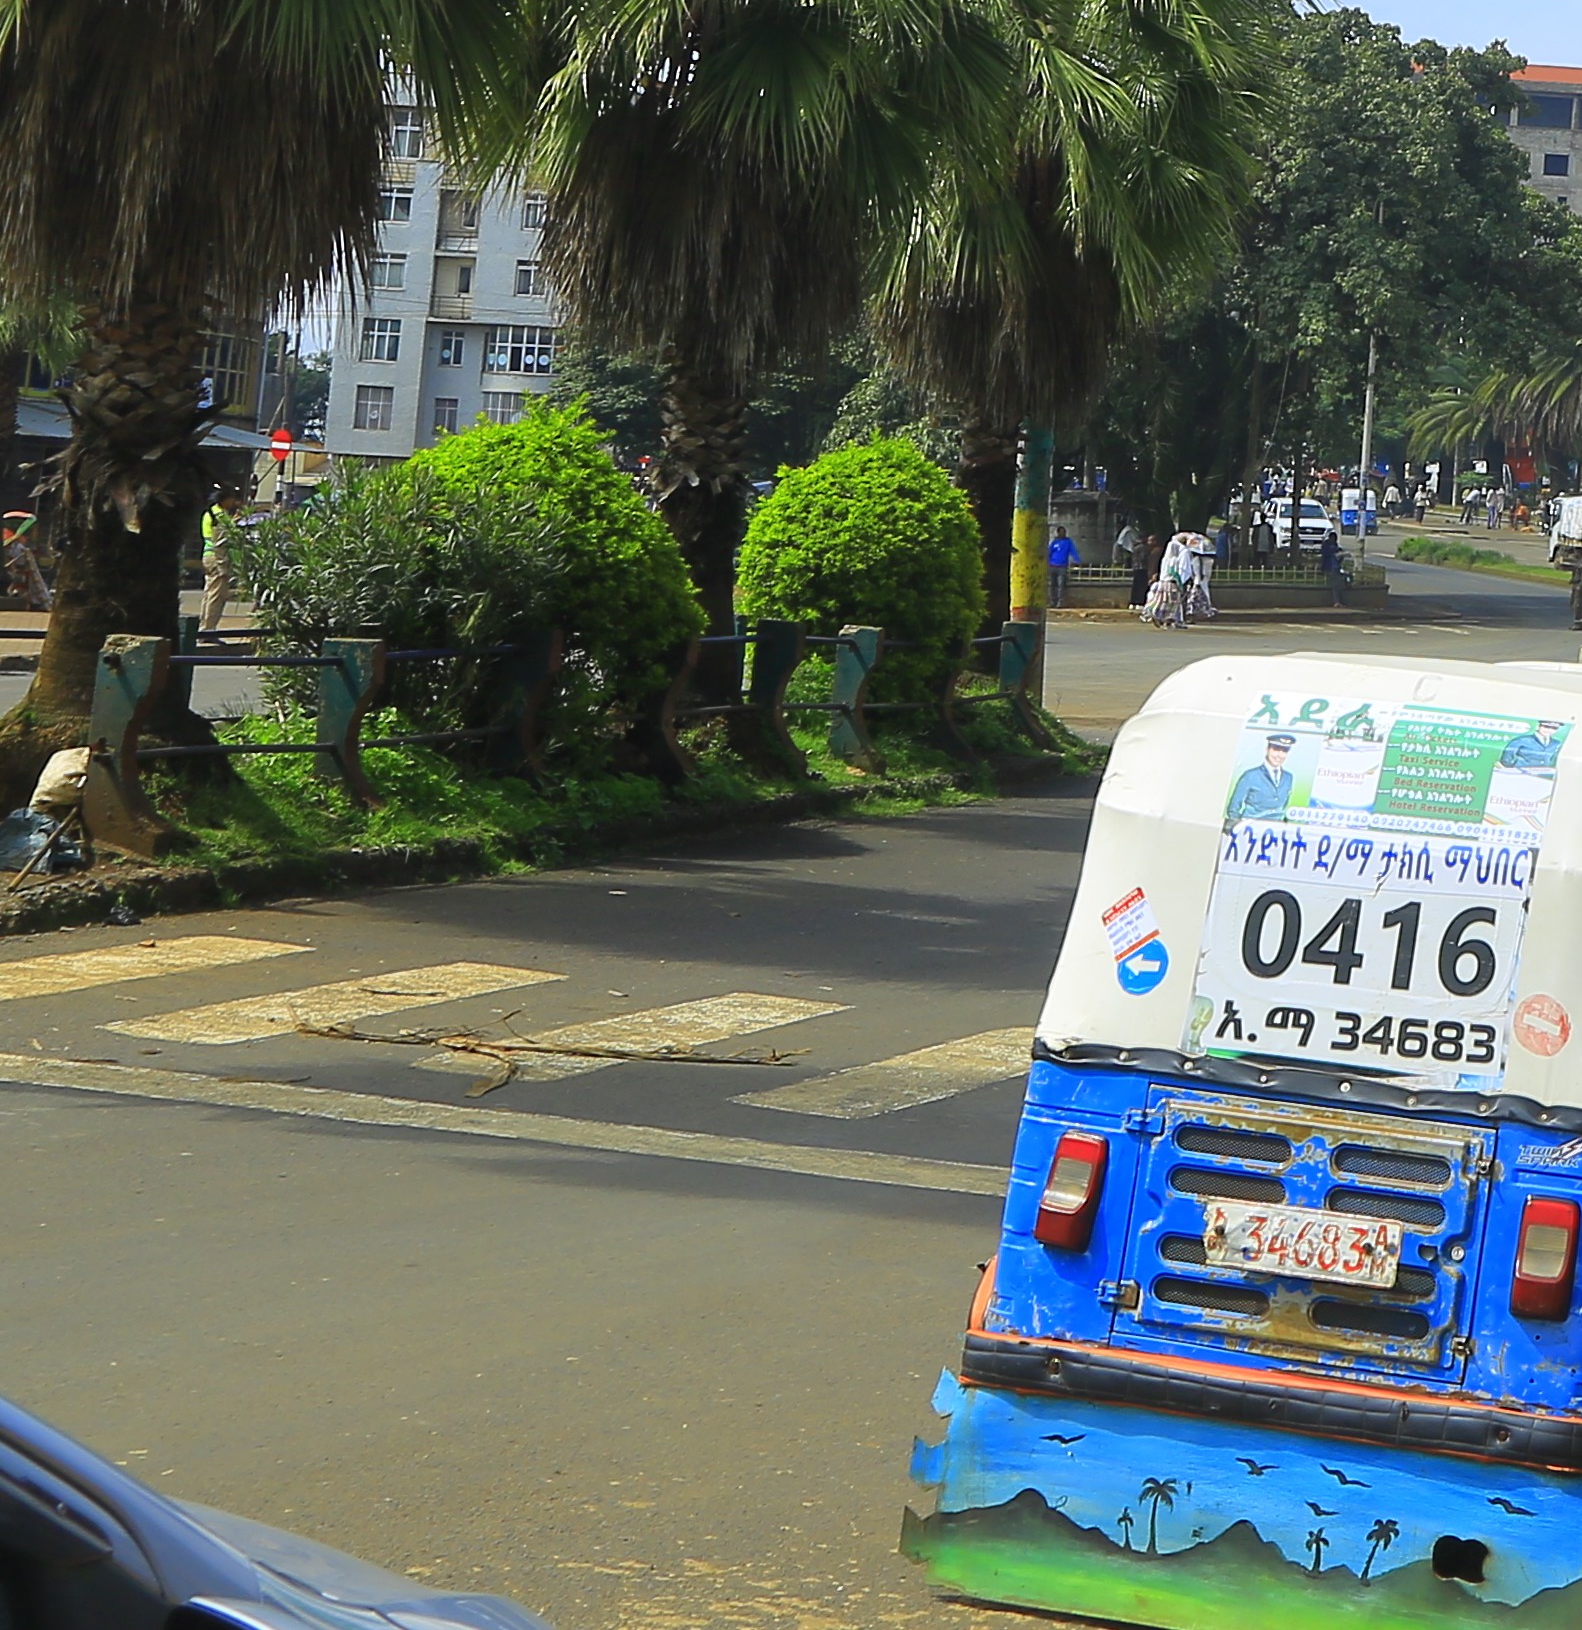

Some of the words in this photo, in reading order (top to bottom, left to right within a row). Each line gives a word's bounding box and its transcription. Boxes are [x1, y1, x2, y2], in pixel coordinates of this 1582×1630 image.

[1434, 745, 1481, 759] አገልግሎት
[1399, 754, 1419, 764] Taxi
[1423, 756, 1460, 768] Service
[1317, 768, 1366, 780] Ethiopian
[1427, 768, 1474, 782] አገልግሎት
[1394, 777, 1413, 787] Bed
[1417, 779, 1477, 794] Reservation
[1426, 791, 1473, 806] አገልግሎት
[1489, 795, 1540, 809] Ethiopian
[1388, 800, 1417, 811] Hotel
[1420, 803, 1481, 817] Reservation
[1456, 824, 1538, 841] 0904151825
[1224, 825, 1308, 869] አንድነት
[1377, 840, 1434, 884] ታክሲ
[1444, 845, 1529, 890] ማህበር
[1241, 888, 1498, 997] 0416
[1214, 999, 1316, 1048] አ.ማ
[1330, 1010, 1498, 1064] 34683
[1243, 1215, 1371, 1273] 34683
